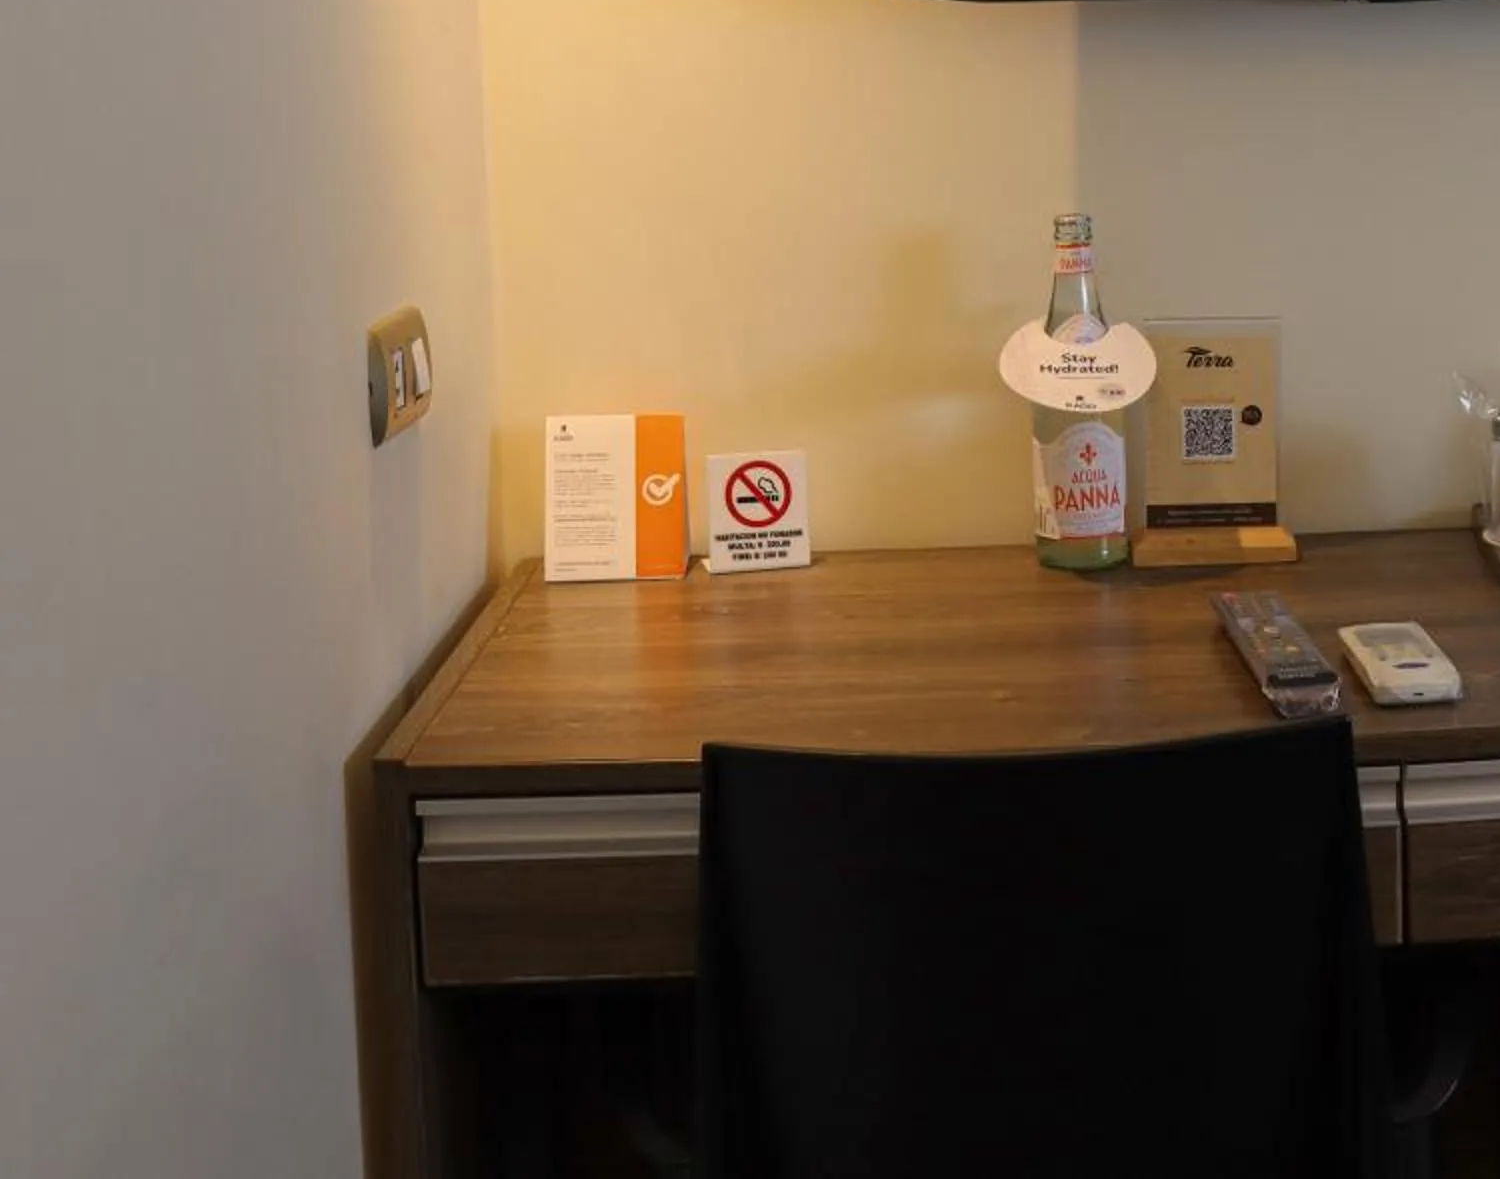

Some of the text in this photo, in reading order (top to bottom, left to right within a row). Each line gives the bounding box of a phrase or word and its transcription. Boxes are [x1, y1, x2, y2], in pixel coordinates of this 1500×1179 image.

[1061, 353, 1097, 364] Stay
[1184, 347, 1234, 368] Terra
[1040, 364, 1119, 374] Hydrated!
[1071, 469, 1107, 484] ACQUA
[1053, 483, 1121, 512] PANNA
